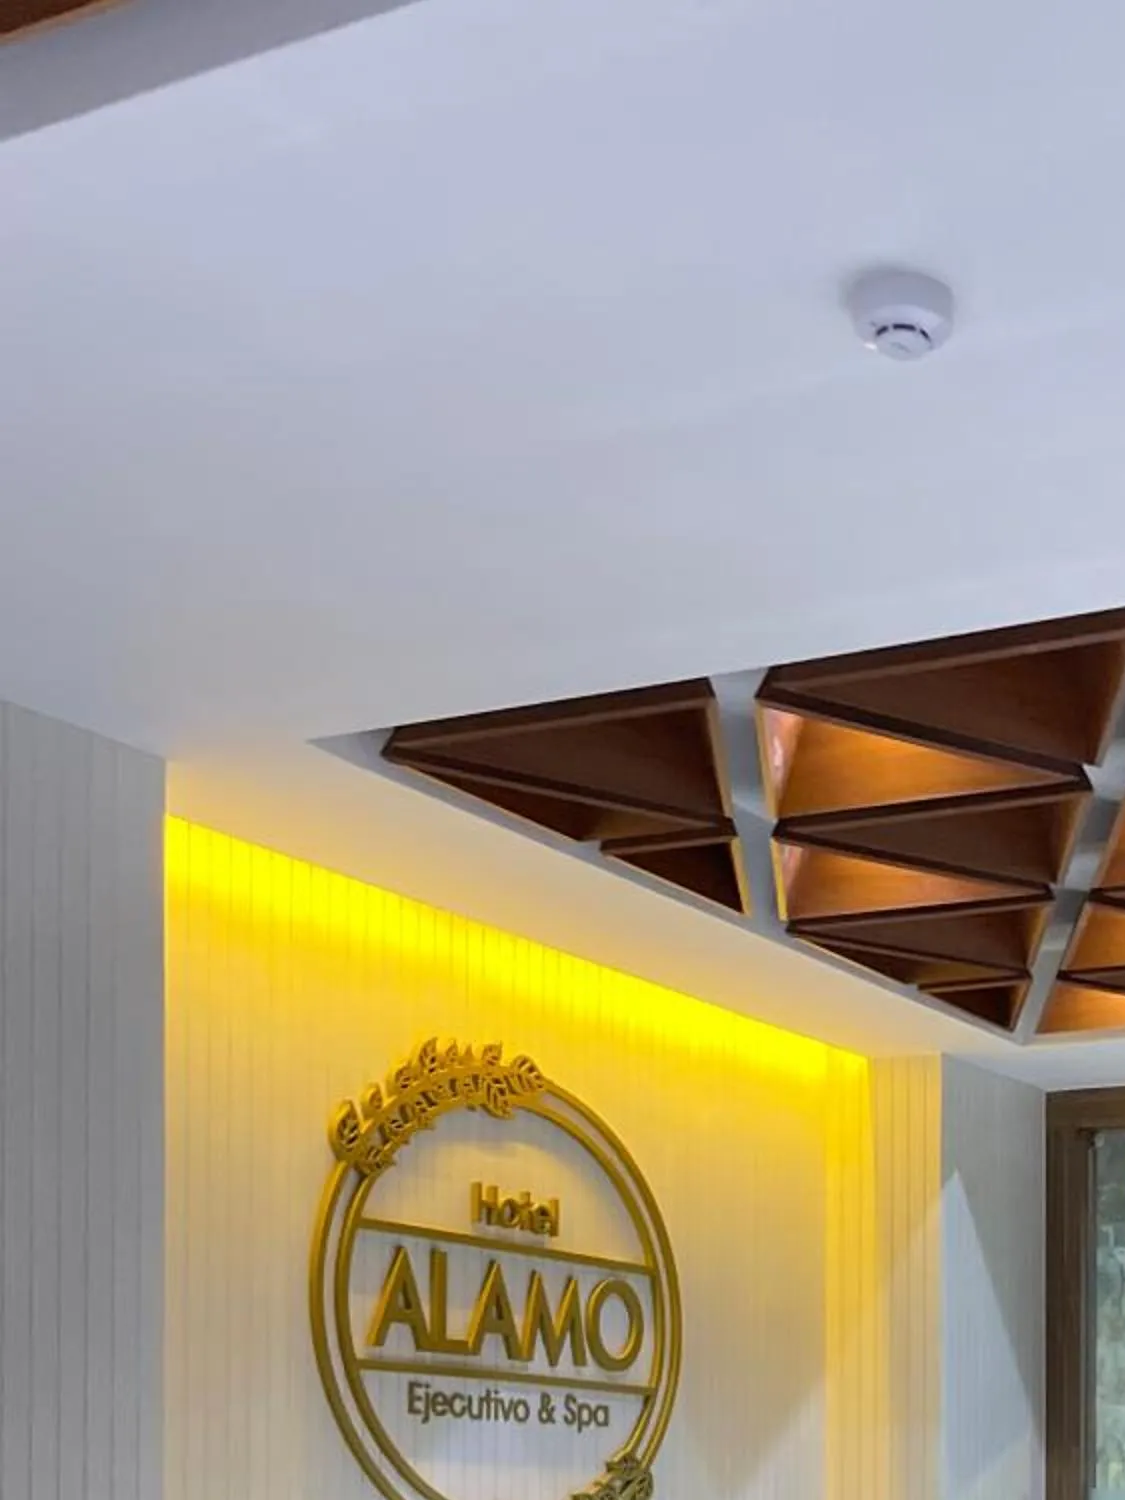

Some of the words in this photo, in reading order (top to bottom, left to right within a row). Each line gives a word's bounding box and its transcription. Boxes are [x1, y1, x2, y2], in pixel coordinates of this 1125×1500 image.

[470, 1181, 560, 1237] Hotel
[366, 1245, 644, 1371] ALAMO
[407, 1381, 530, 1424] Ejecutivo
[538, 1392, 556, 1424] &
[564, 1394, 609, 1433] Spa
